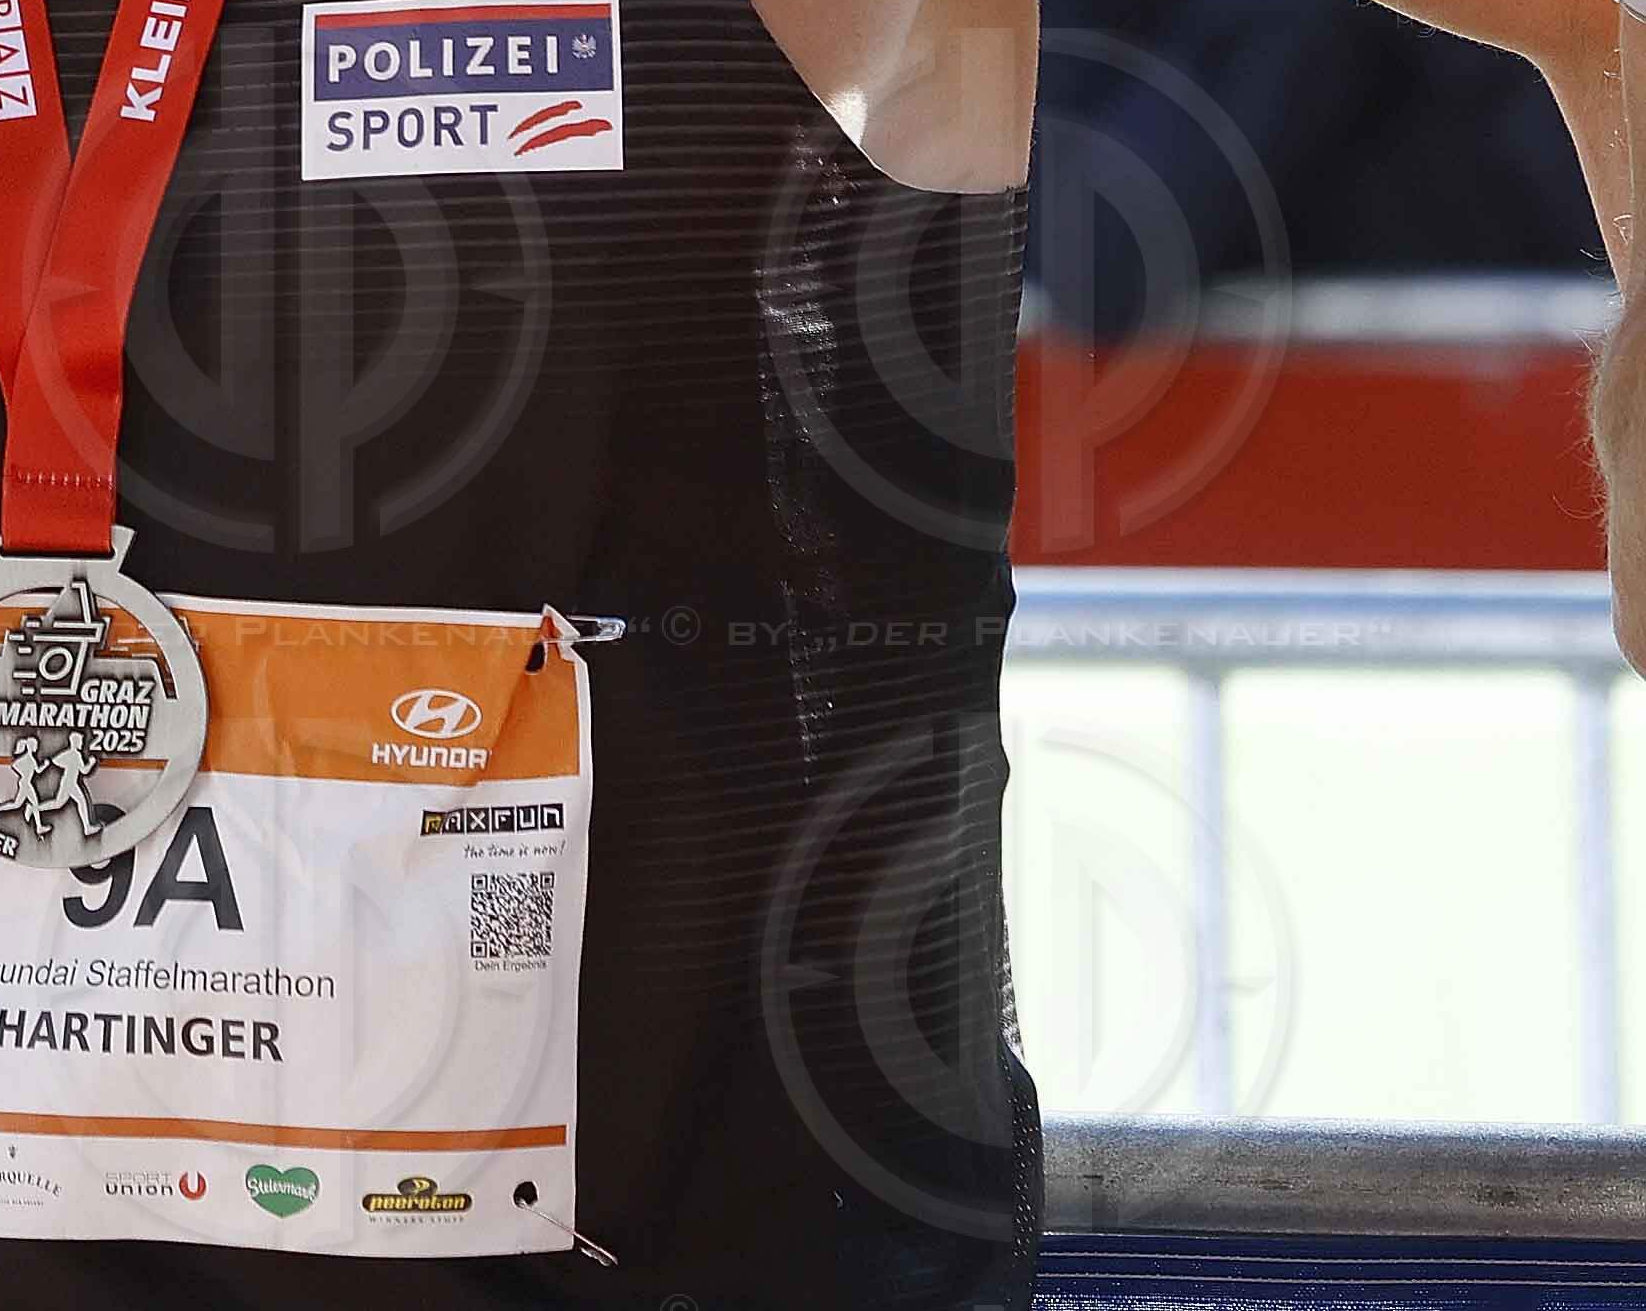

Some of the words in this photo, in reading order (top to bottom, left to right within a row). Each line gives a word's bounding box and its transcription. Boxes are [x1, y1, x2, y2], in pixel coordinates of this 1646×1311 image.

[327, 35, 559, 83] POLIZEI
[325, 104, 499, 152] SPORT
[79, 679, 156, 705] GRAZ
[89, 730, 146, 753] 2025
[86, 958, 337, 999] Staffelmarathon
